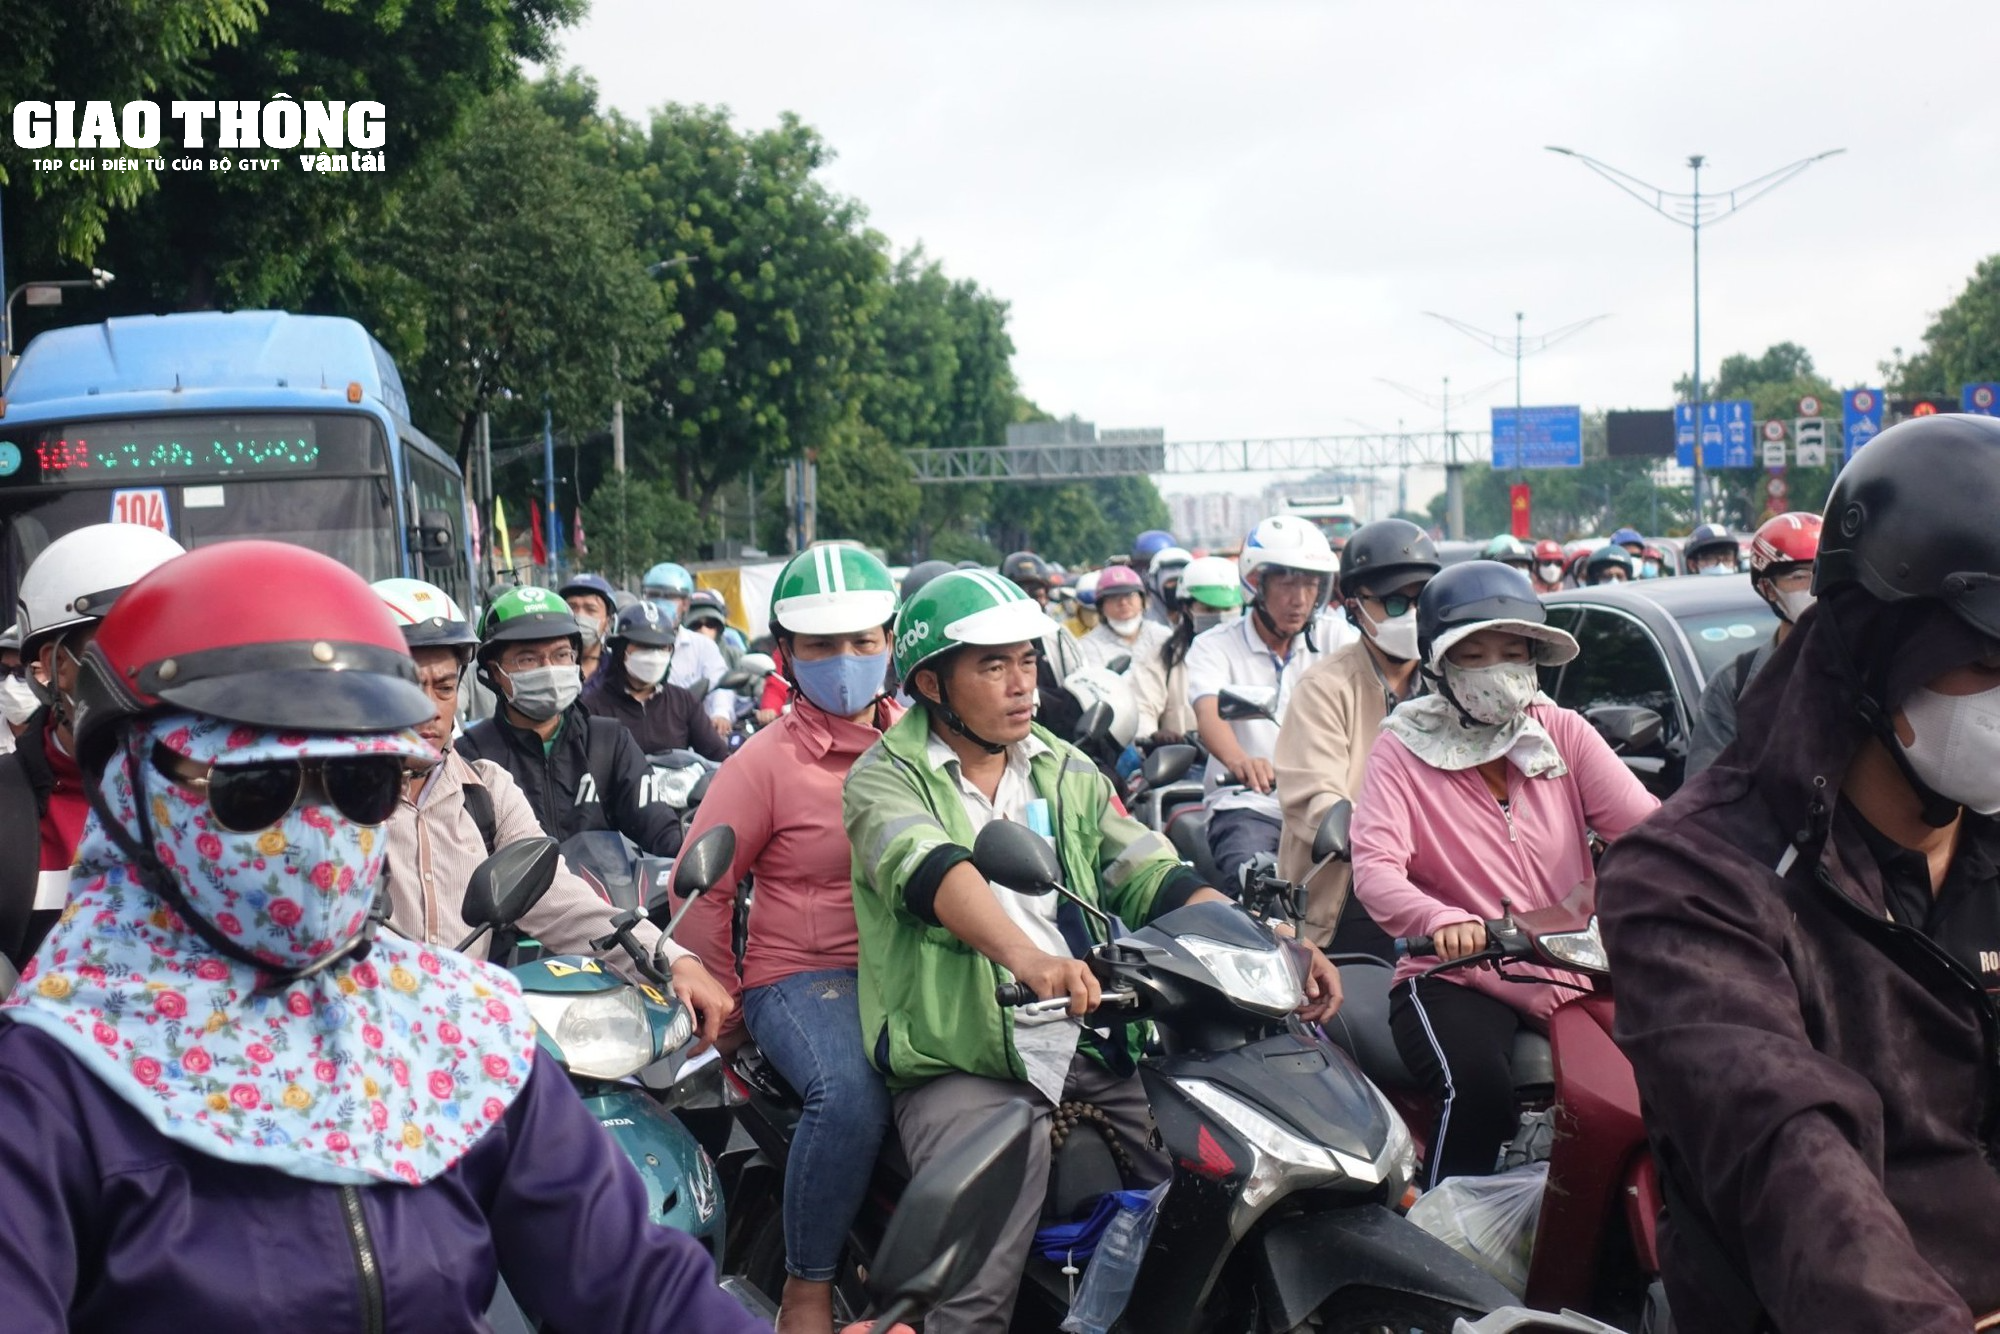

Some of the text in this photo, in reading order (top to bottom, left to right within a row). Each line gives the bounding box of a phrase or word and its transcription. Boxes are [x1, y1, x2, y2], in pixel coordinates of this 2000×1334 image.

[116, 494, 166, 529] 104
[895, 619, 930, 659] Grab
[1979, 951, 2000, 973] RO
